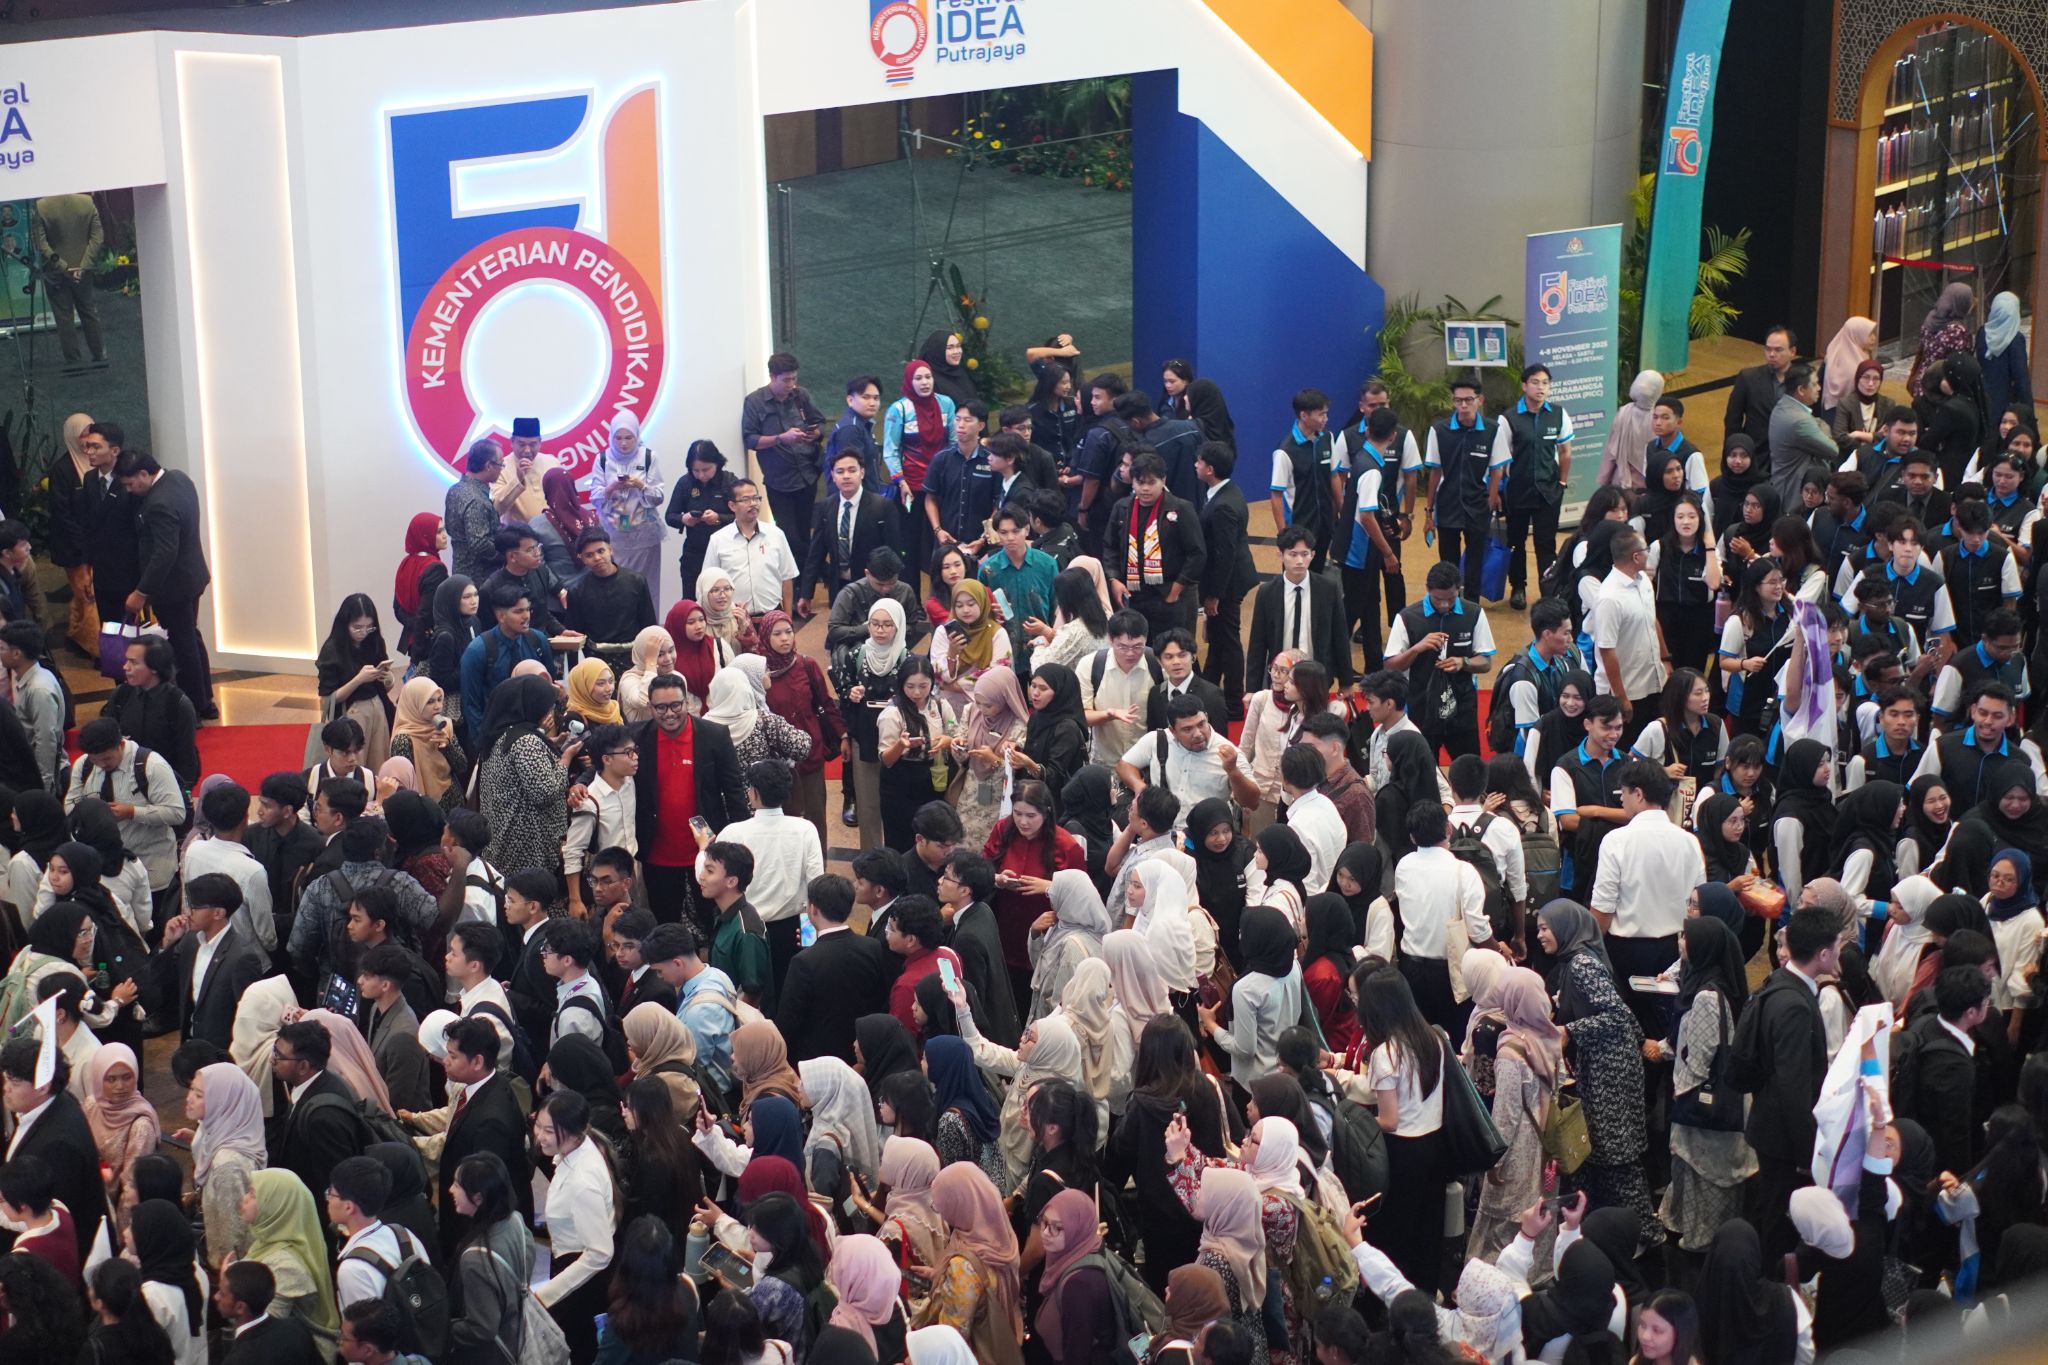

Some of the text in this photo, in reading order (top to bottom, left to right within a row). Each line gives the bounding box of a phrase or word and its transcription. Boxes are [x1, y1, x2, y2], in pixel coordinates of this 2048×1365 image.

[936, 4, 1025, 45] IDEA
[937, 40, 1026, 64] Putrajaya
[1568, 286, 1608, 304] IDEA
[421, 240, 570, 389] KEMENTERIAN
[573, 248, 650, 411] PENDIDIKAN
[1552, 343, 1590, 354] NOVEMBER
[1563, 376, 1604, 386] KONVENSYEN
[1549, 383, 1604, 396] NTARABANGSA
[1546, 393, 1582, 403] UTRAJAYA
